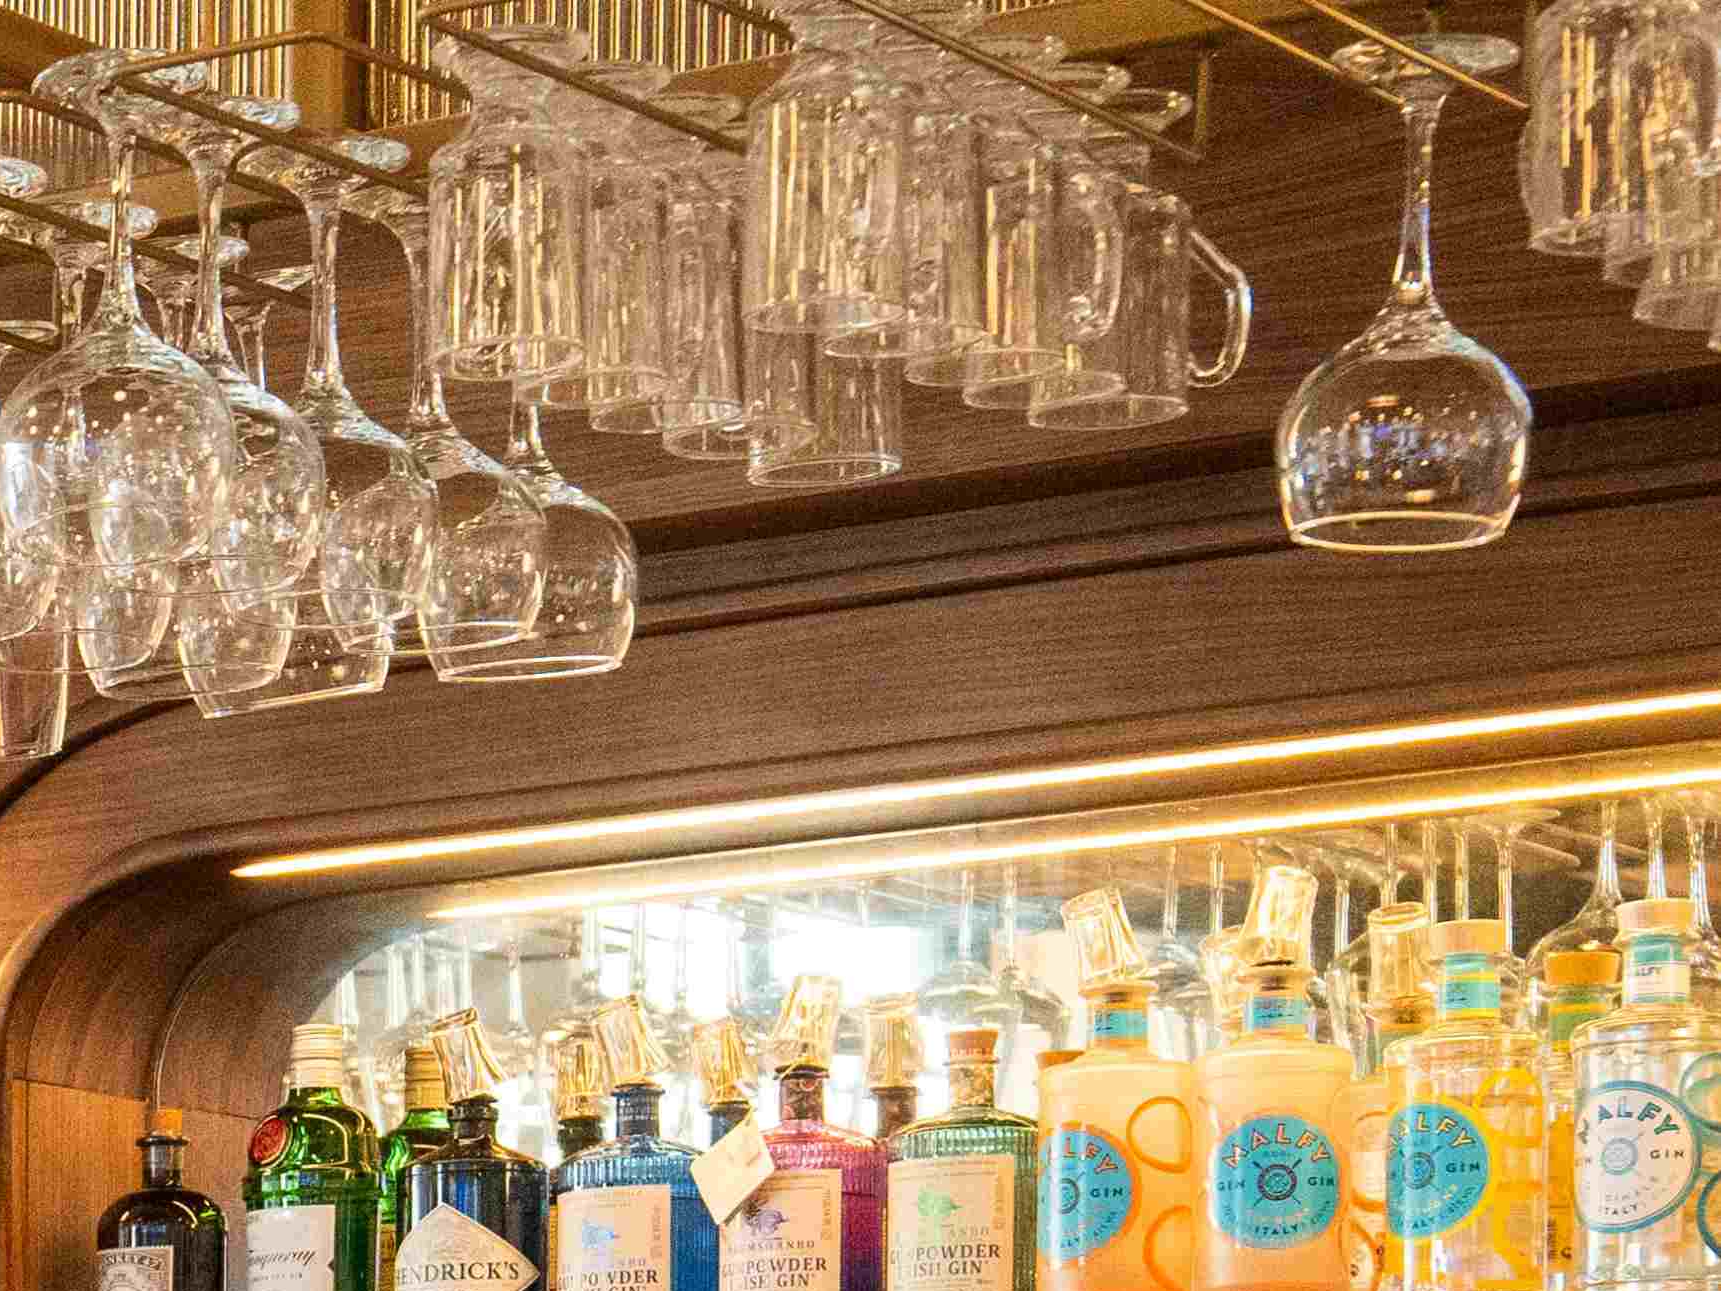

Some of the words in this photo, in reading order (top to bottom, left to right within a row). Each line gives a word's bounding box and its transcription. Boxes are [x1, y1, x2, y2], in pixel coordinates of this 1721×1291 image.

[1222, 1123, 1330, 1168] MALFY
[1650, 1149, 1684, 1159] GIN
[1446, 1161, 1479, 1173] GIN
[1308, 1176, 1335, 1187] GIN
[1090, 1187, 1123, 1198] GIN
[890, 1243, 1000, 1264] GUPOWDER
[722, 1257, 827, 1277] GUPOWDER
[948, 1260, 982, 1275] GIN
[776, 1272, 809, 1288] GIN
